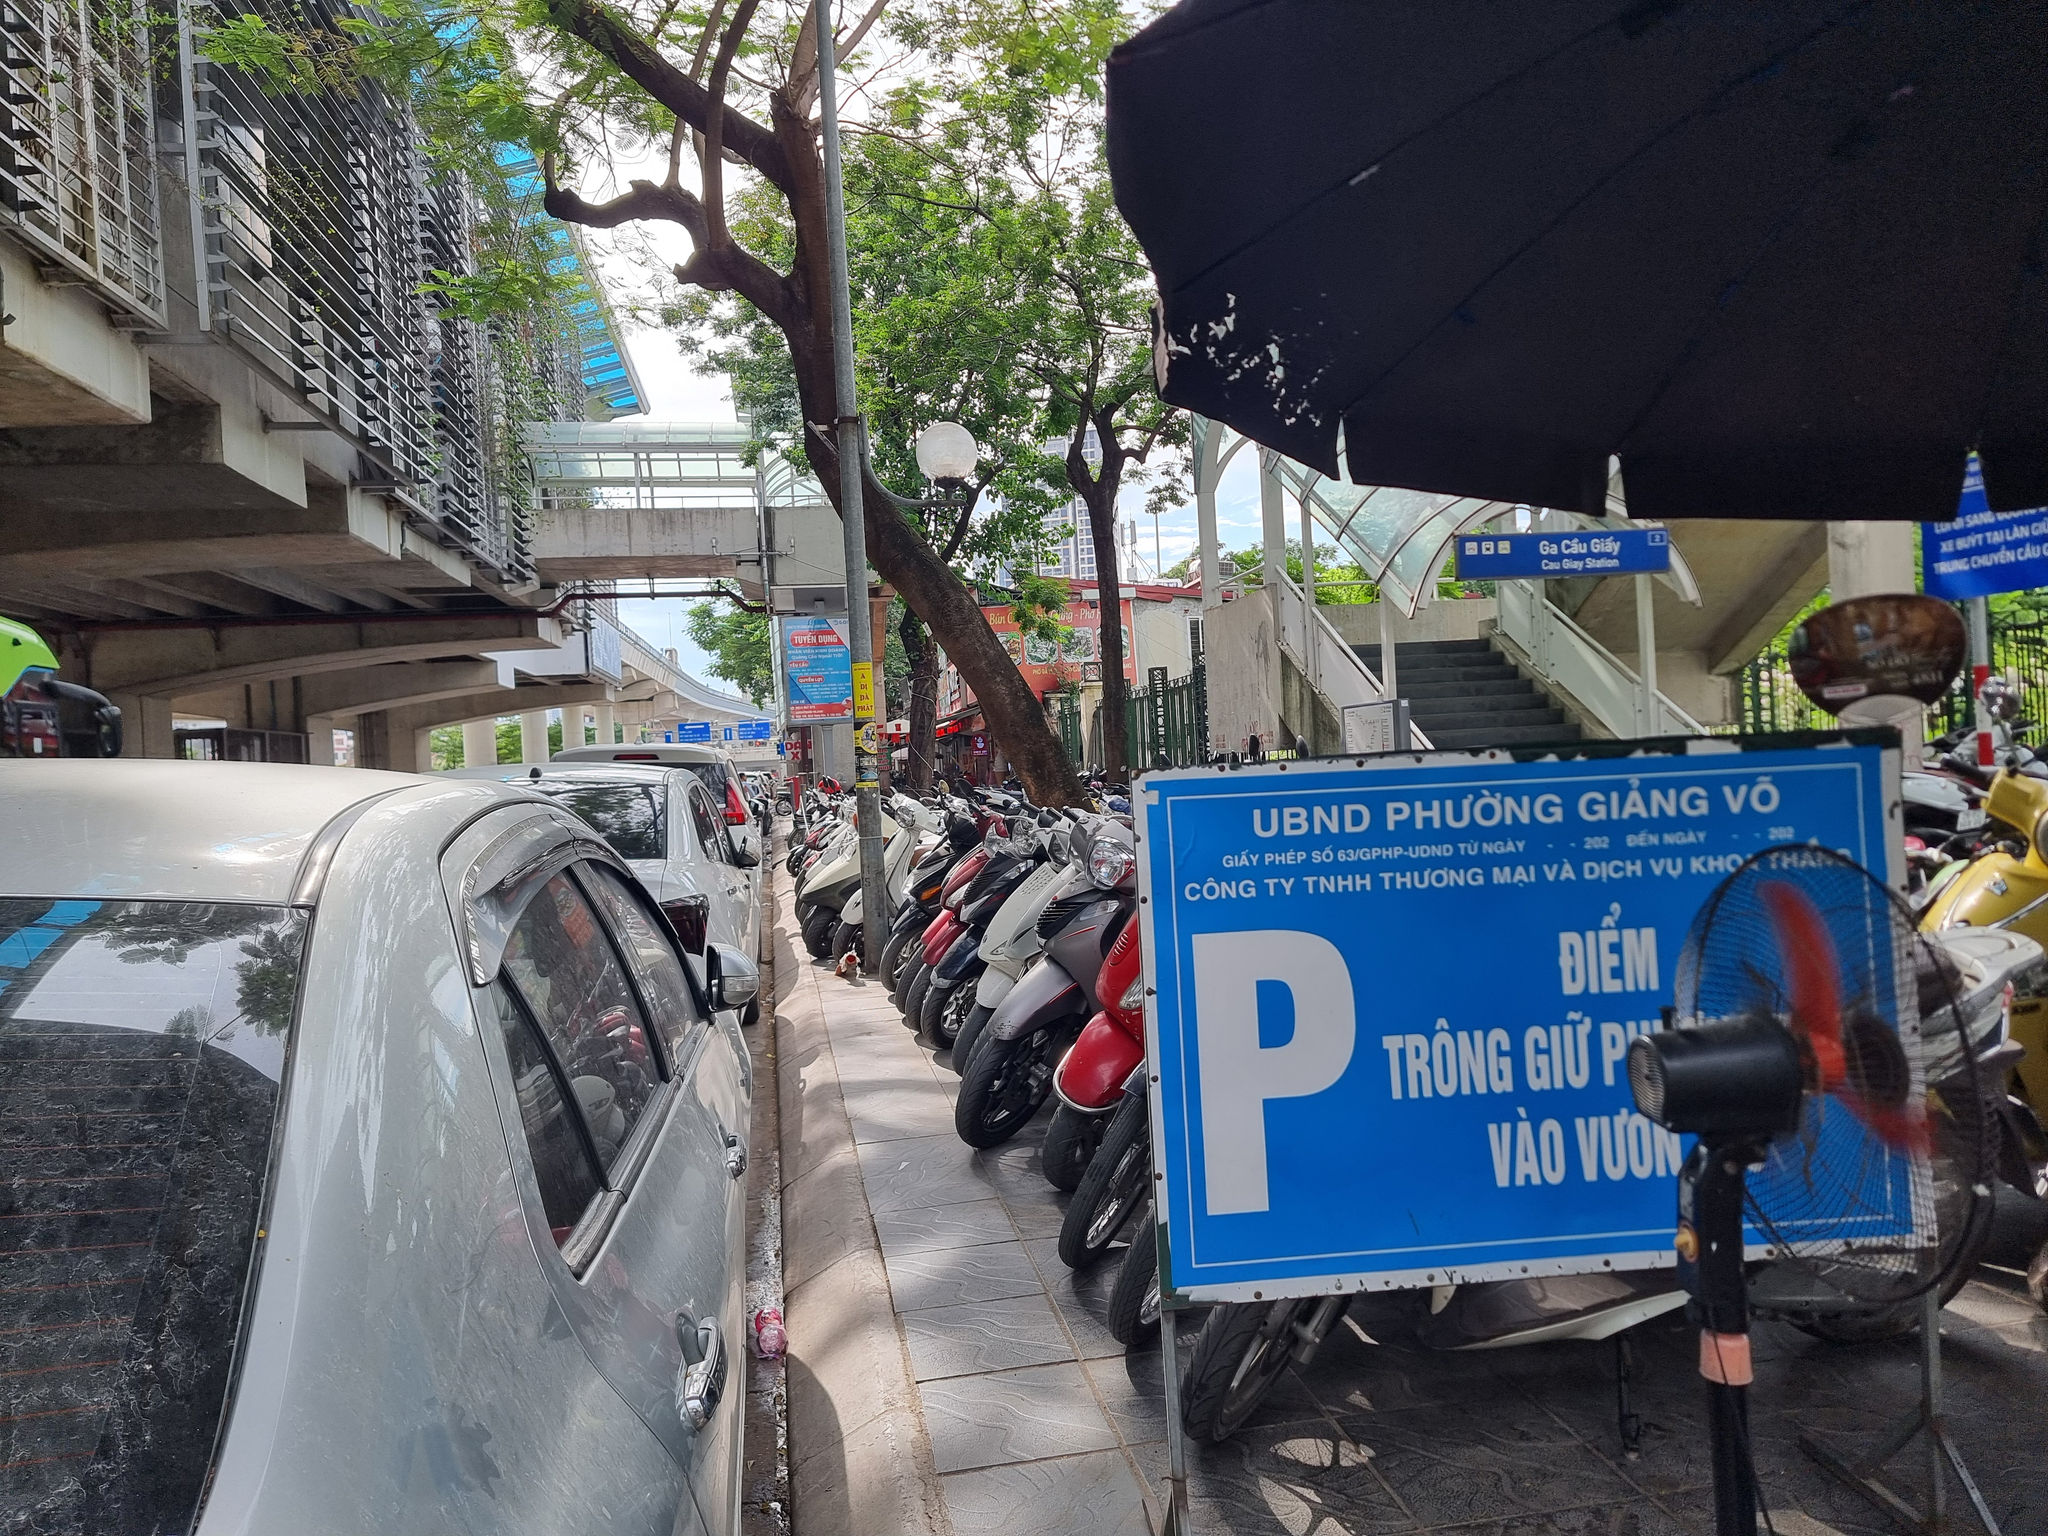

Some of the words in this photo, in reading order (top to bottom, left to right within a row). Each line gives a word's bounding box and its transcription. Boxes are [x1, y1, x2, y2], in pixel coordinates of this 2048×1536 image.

[1539, 540, 1558, 555] Ga
[1561, 537, 1587, 555] Cầu
[1590, 536, 1620, 556] Giấy
[1933, 557, 1970, 575] TRUNG
[1970, 545, 2015, 570] CHUYỂN
[2016, 542, 2041, 561] CẦU
[1940, 539, 1955, 553] XE
[1984, 529, 2004, 545] TẠI
[2005, 524, 2030, 541] LÀN
[1541, 559, 1560, 571] Cau
[1562, 558, 1584, 571] Giay
[1585, 557, 1620, 569] Station
[794, 632, 817, 644] TUYỂN
[818, 634, 838, 645] DỤNG
[1252, 804, 1371, 838] UBND
[1386, 789, 1563, 831] PHƯỜNG
[1577, 779, 1709, 821] GIẢNG
[1723, 775, 1780, 814] VÕ
[1222, 850, 1258, 868] GIẤY
[1264, 849, 1306, 865] PHÉP
[1311, 845, 1334, 863] SỐ
[1457, 840, 1479, 856] TỪ
[1482, 837, 1526, 855] NGÀY
[1584, 836, 1610, 849] 202
[1626, 829, 1659, 847] ĐẾN
[1663, 829, 1707, 846] NGÀY
[1184, 877, 1256, 901] CÔNG
[1264, 878, 1295, 897] TY
[1303, 874, 1372, 894] TNHH
[1379, 867, 1484, 889] THƯƠNG
[1493, 864, 1536, 887] MẠI
[1543, 859, 1576, 881] VÀ
[1583, 858, 1642, 883] DỊCH
[1649, 857, 1683, 880] VỤ
[1559, 902, 1660, 995] ĐIỂM
[1192, 929, 1356, 1216] P
[1382, 1017, 1514, 1100] TRÔNG
[1523, 1011, 1593, 1091] GIỮ
[1487, 1106, 1567, 1188] VÀO
